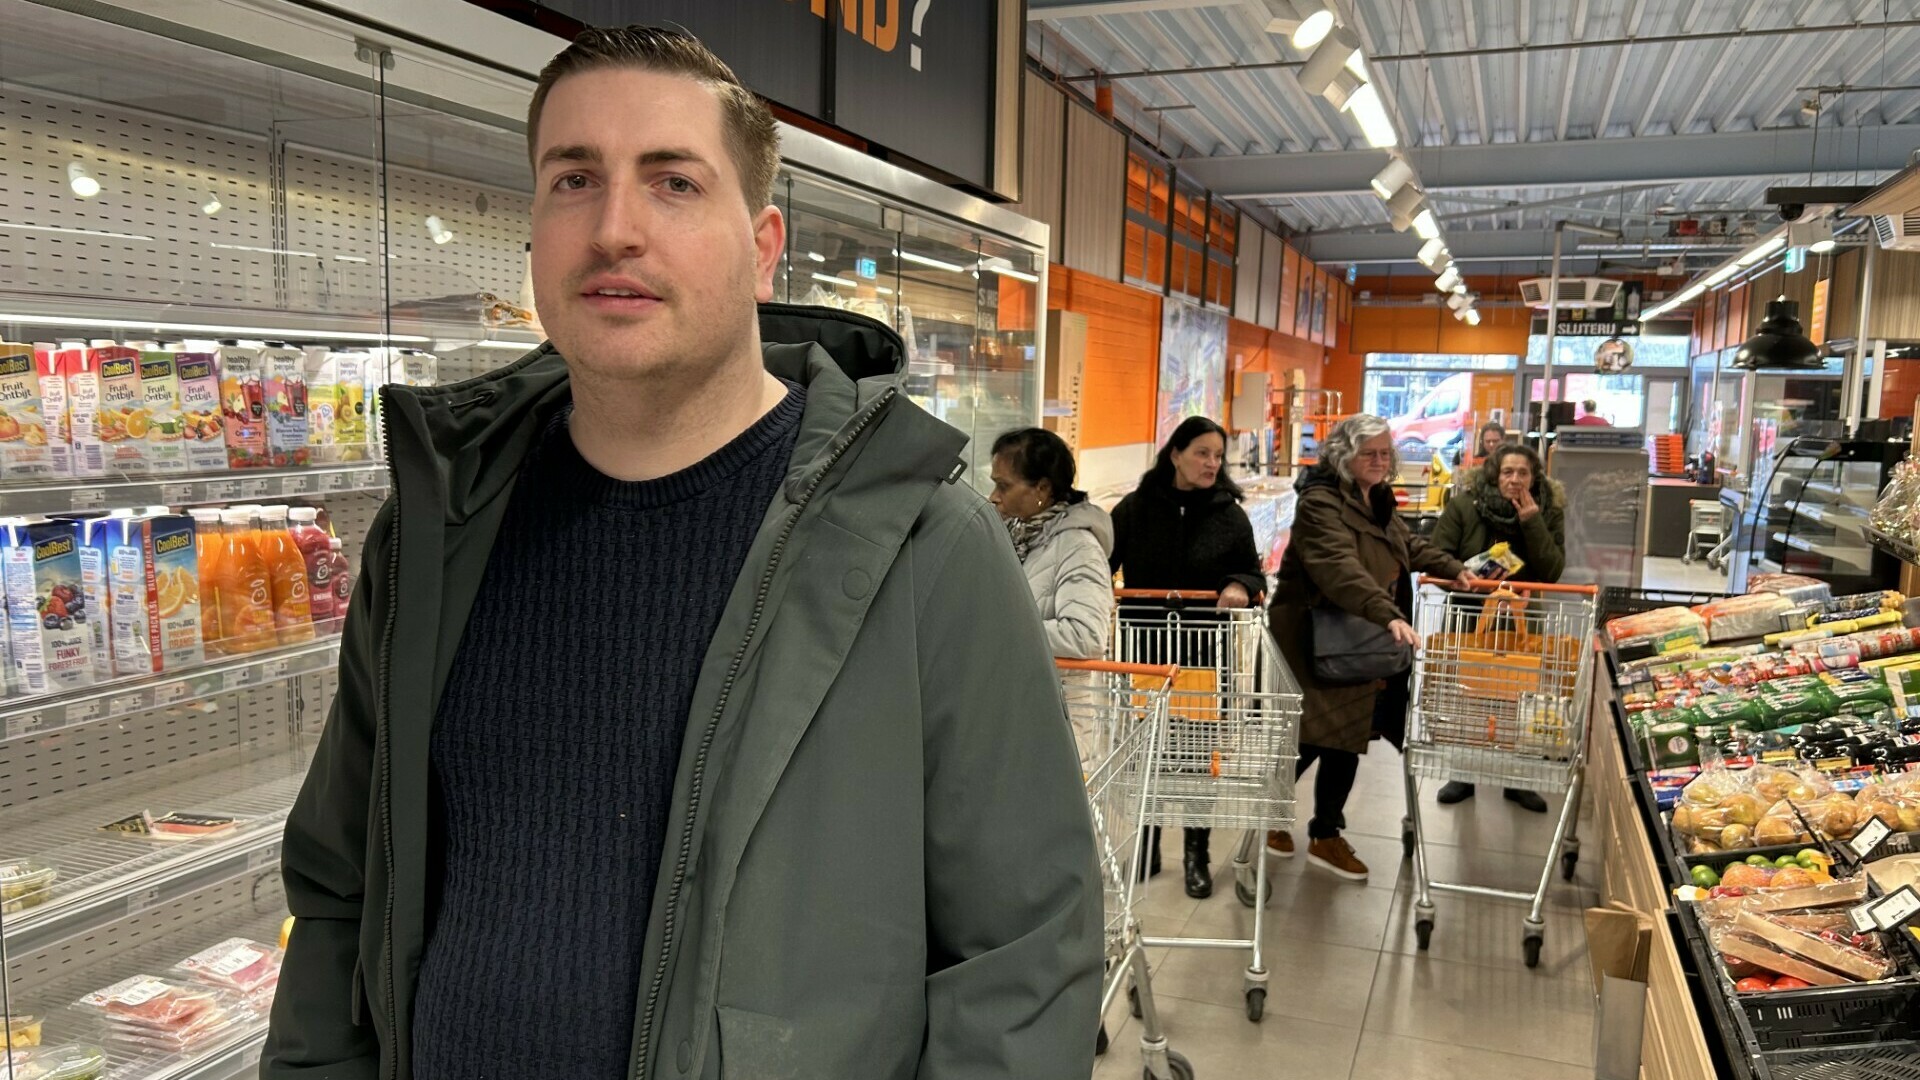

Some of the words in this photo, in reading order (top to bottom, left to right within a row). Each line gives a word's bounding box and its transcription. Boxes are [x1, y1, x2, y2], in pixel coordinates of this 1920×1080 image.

[1557, 322, 1616, 335] SLIJTERIJ
[103, 360, 133, 377] CoolBest
[141, 363, 171, 377] CoolBest
[181, 364, 210, 379] CoolBest
[2, 381, 24, 392] Fruit
[108, 384, 128, 393] Fruit
[147, 384, 166, 394] Fruit
[188, 385, 206, 394] Fruit
[105, 391, 135, 402] Ontbijt
[144, 391, 173, 403] Ontbijt
[184, 391, 212, 403] Ontbijt
[36, 538, 72, 560] CoolBest
[156, 532, 191, 553] CoolBest
[145, 550, 154, 569] PACK
[147, 569, 157, 592] VALUE
[150, 616, 160, 634] PACK
[56, 647, 80, 660] FUNKY
